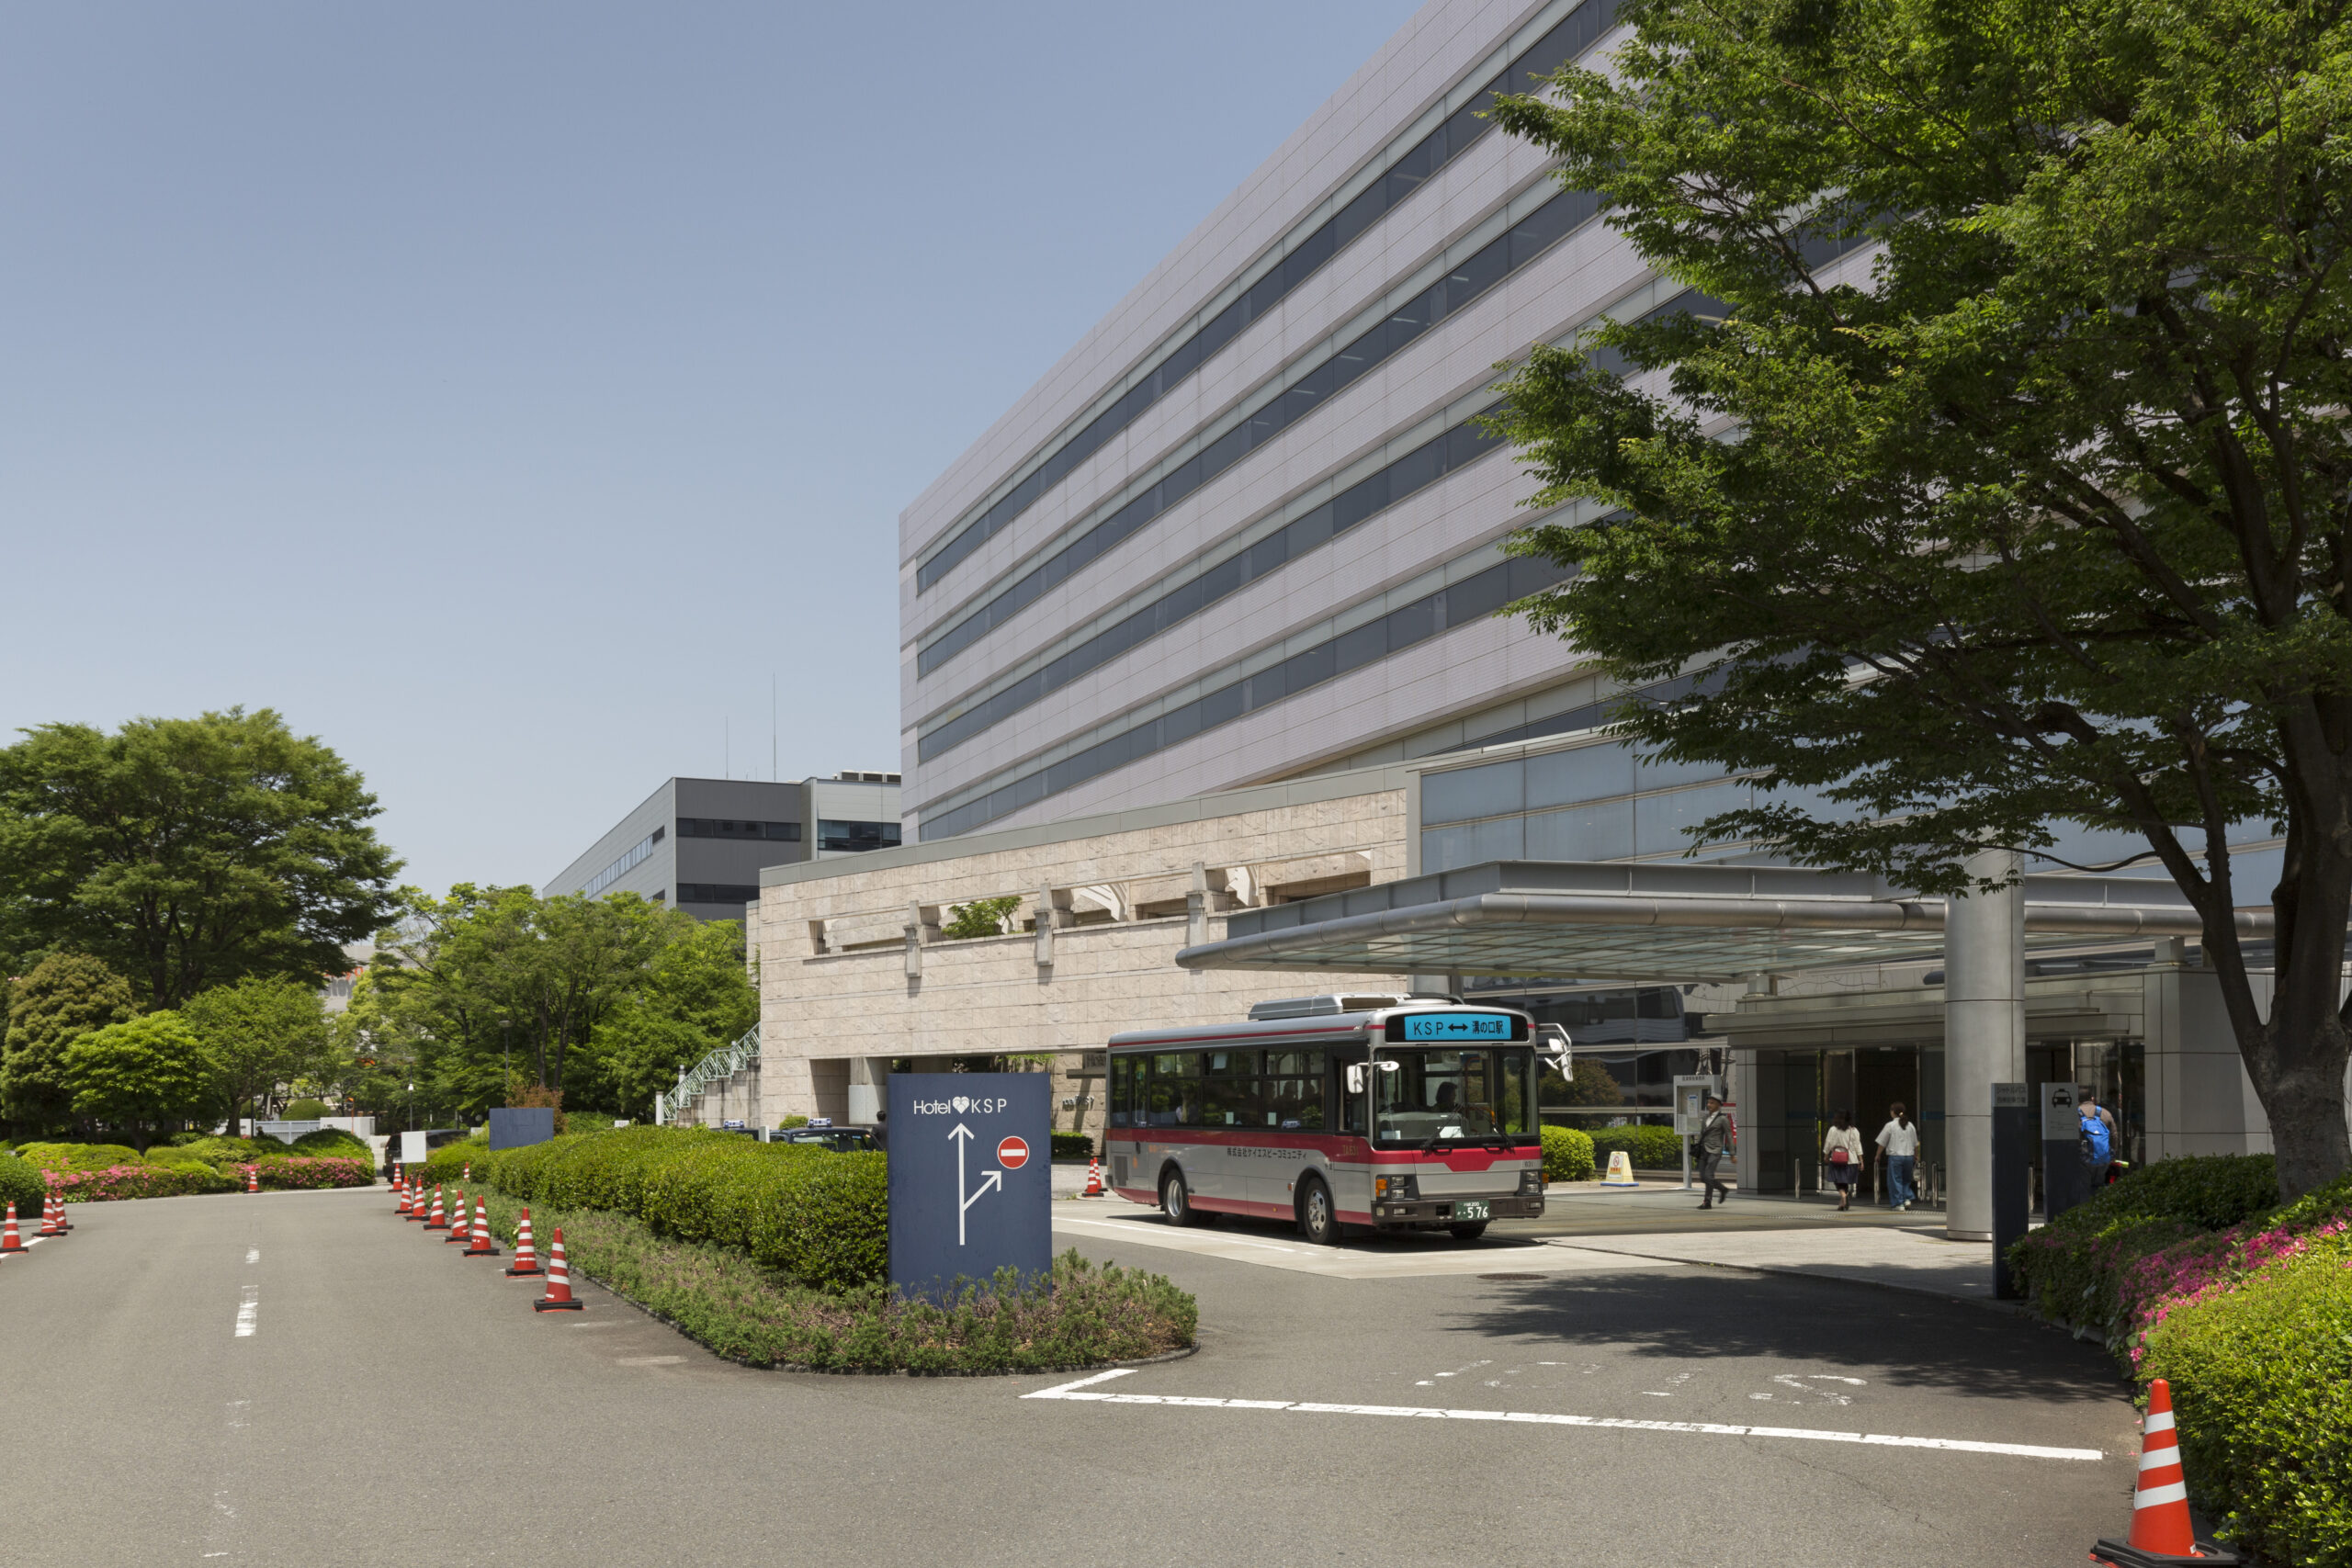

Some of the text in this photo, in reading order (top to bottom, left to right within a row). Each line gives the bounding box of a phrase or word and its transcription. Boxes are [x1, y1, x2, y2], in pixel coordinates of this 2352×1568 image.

[1413, 1021, 1504, 1035] KSP 溝の口駅
[913, 1099, 1007, 1115] Hotel KSP
[1467, 1206, 1488, 1219] 576
